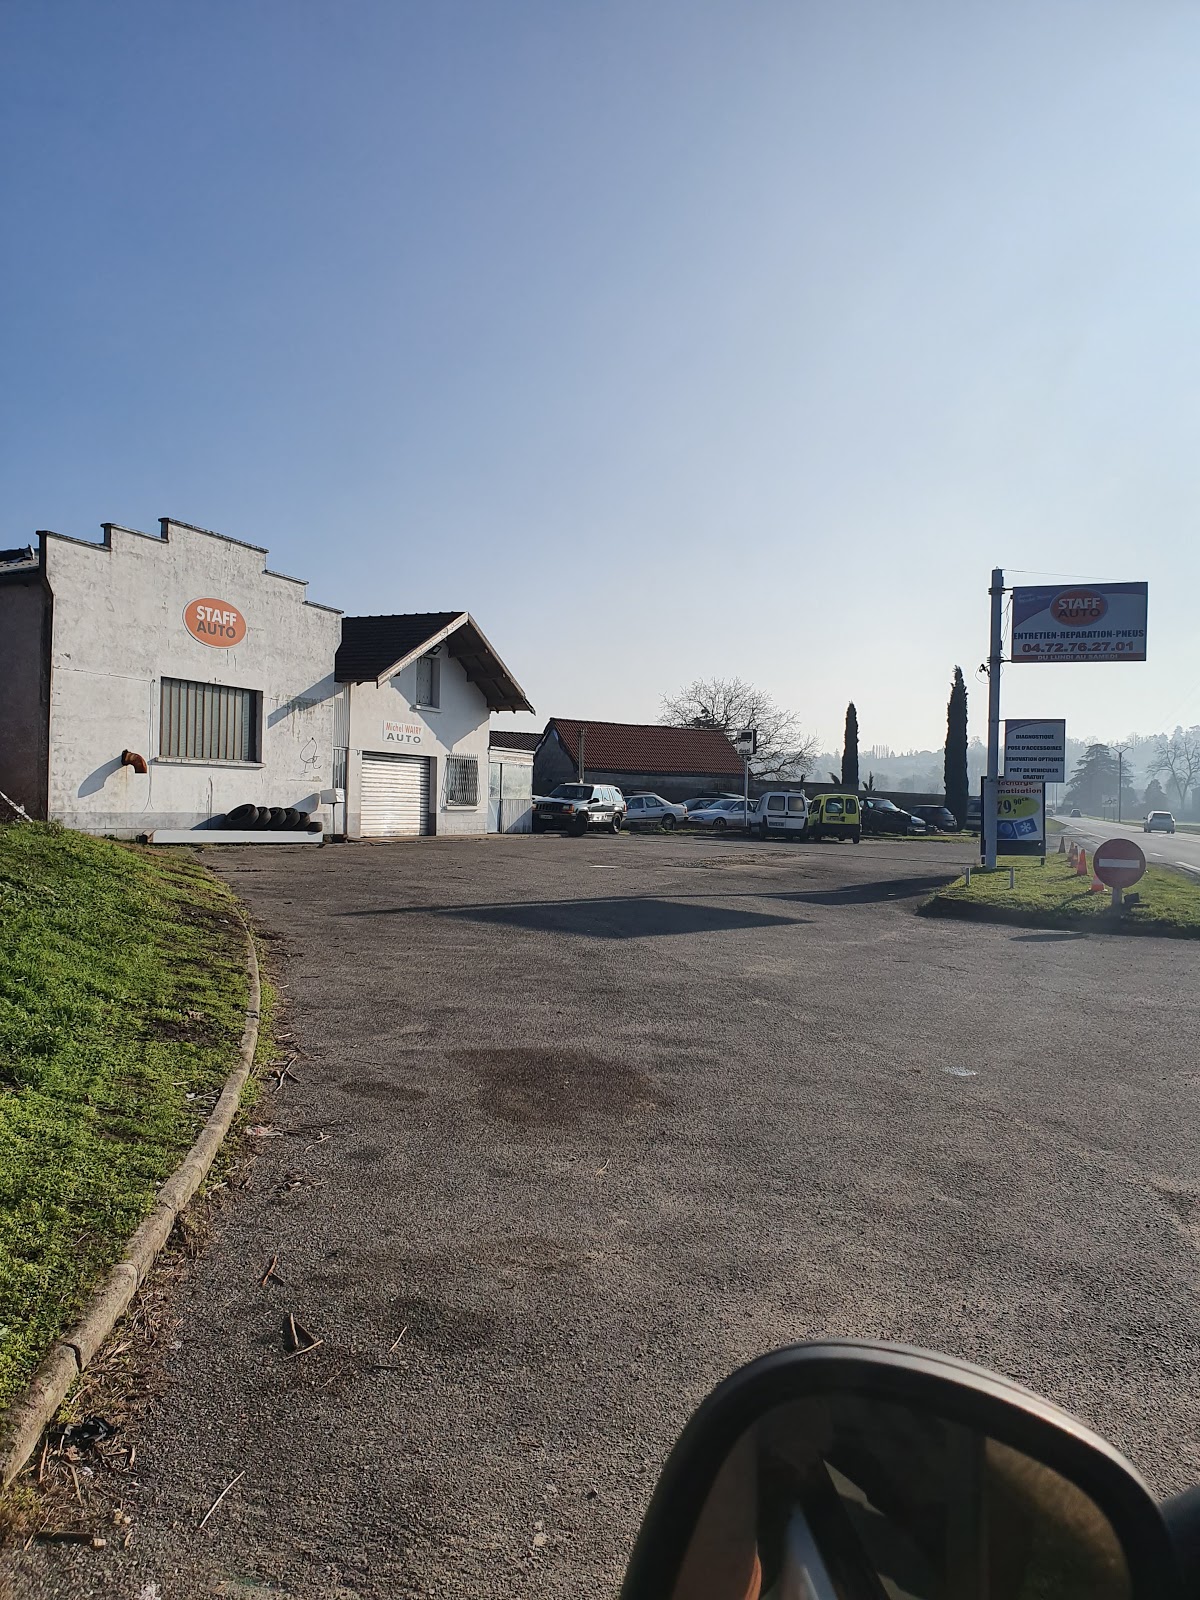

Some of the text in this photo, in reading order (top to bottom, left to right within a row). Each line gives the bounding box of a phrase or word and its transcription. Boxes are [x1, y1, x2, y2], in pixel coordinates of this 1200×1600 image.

[1058, 597, 1100, 610] STAFF
[196, 605, 237, 626] STAFF
[1057, 608, 1101, 618] AUTO
[197, 621, 236, 639] AUTO
[1014, 629, 1144, 640] ENTRETIEN-REPARATION-PNEUS
[1022, 641, 1134, 653] 04.72.76.27.01
[387, 732, 421, 744] AUTO
